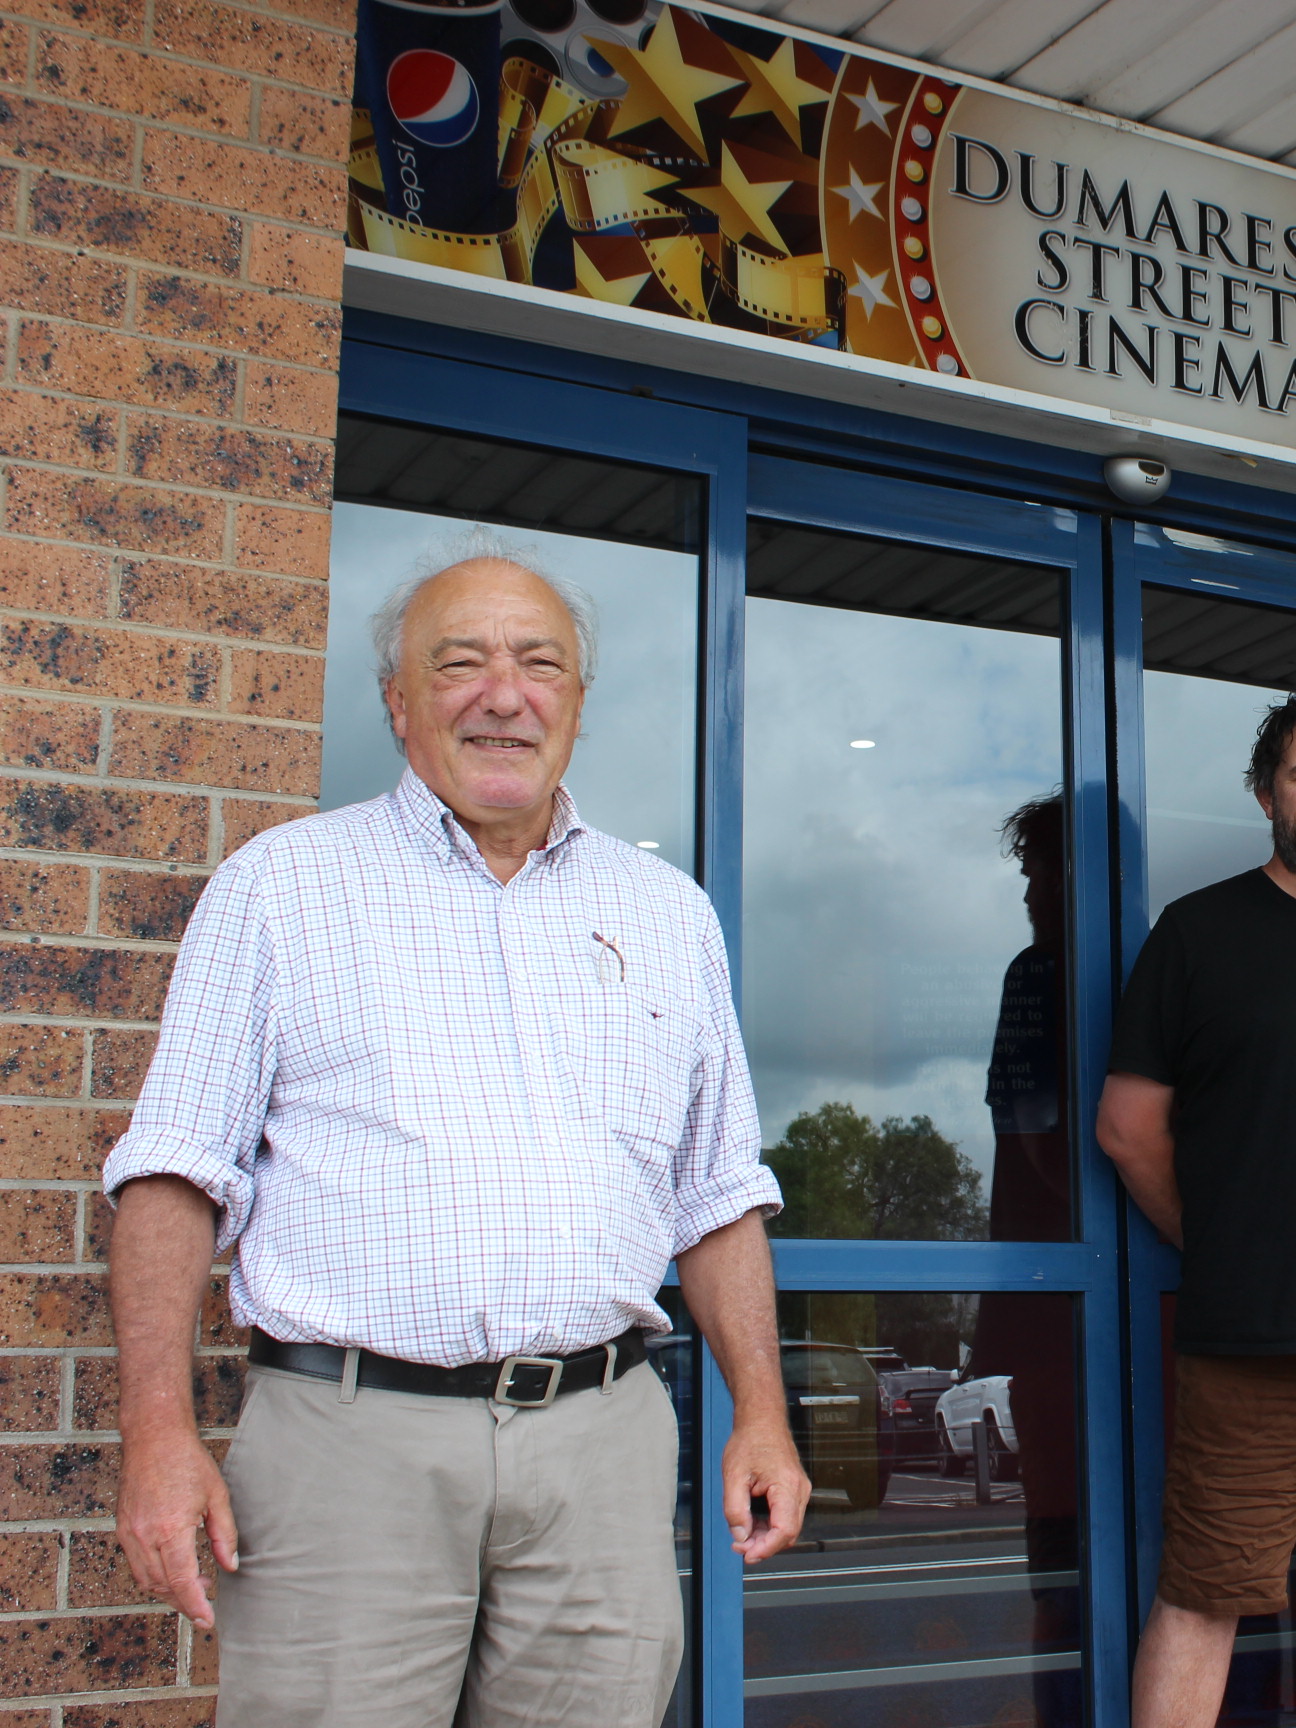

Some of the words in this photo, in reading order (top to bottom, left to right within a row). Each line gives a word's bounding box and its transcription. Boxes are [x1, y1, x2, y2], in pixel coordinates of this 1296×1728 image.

[957, 962, 1024, 976] behavg
[1029, 962, 1044, 974] in
[1007, 980, 1024, 991] or
[1027, 1009, 1042, 1022] to
[1007, 1061, 1032, 1075] not
[991, 1077, 1005, 1090] in
[1011, 1077, 1035, 1090] the
